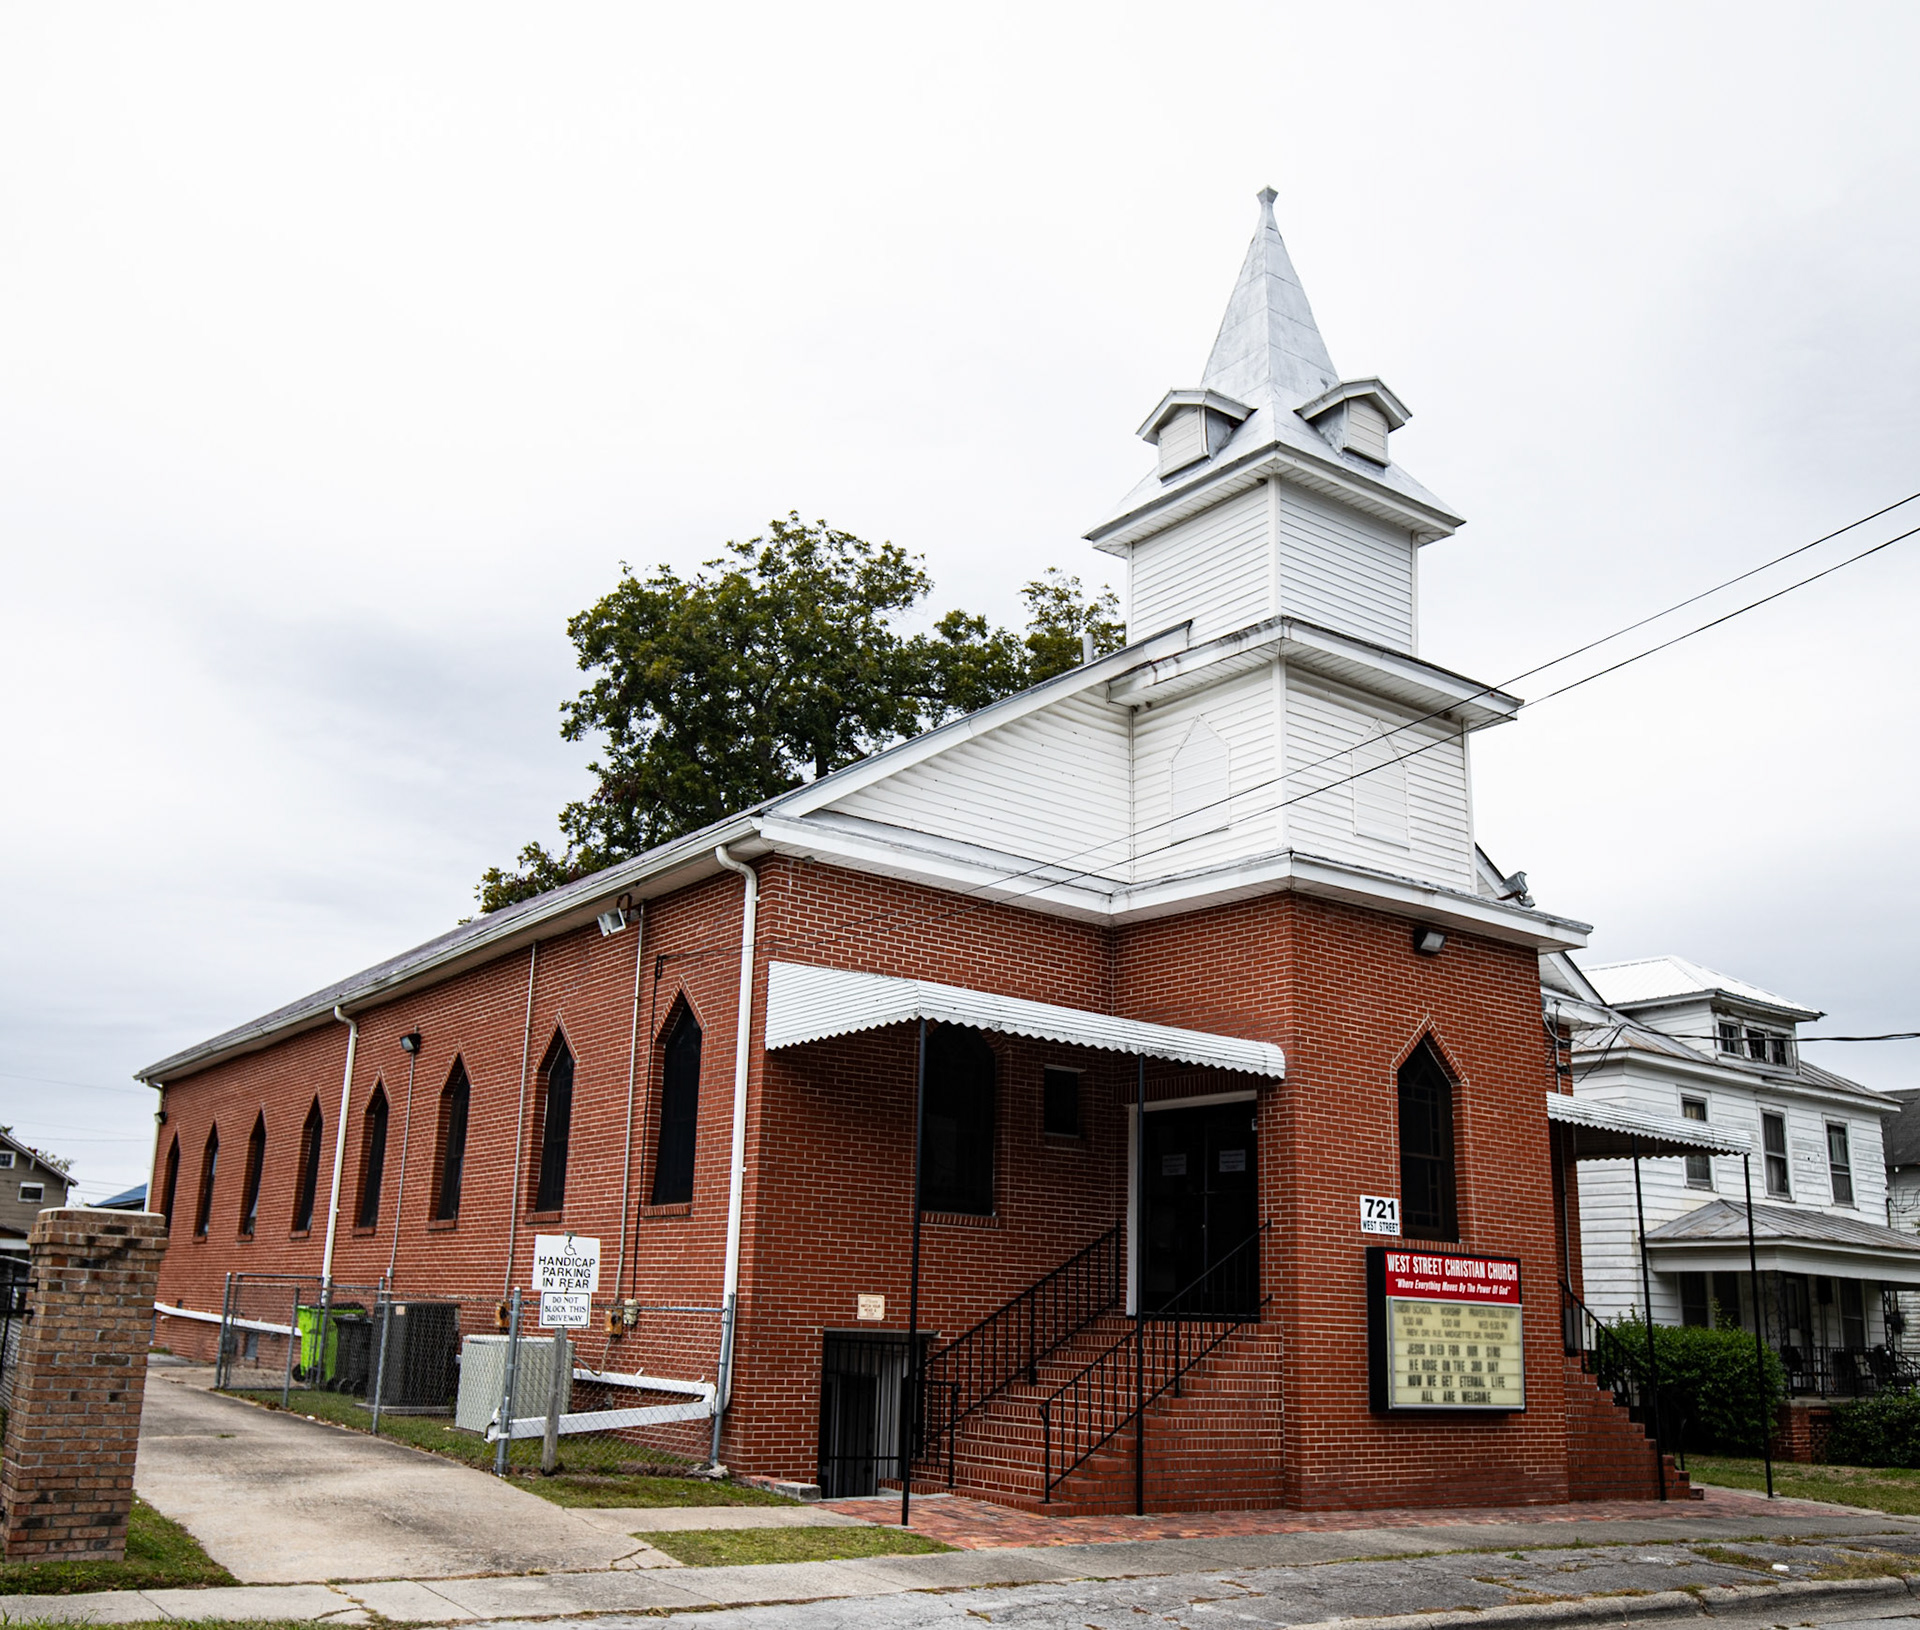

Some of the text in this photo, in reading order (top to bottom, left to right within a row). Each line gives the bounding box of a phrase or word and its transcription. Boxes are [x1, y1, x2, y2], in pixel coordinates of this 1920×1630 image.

[1365, 1199, 1394, 1219] 721
[1363, 1221, 1398, 1233] WEST STREET
[539, 1256, 595, 1267] HANDICAP
[1387, 1254, 1517, 1281] WEST STREET CHRISTIAN CHURCH
[543, 1267, 590, 1278] PARKING
[543, 1278, 589, 1288] IN REAR
[1415, 1280, 1441, 1292] Everything
[1442, 1282, 1458, 1291] Moves
[1459, 1283, 1466, 1293] By
[1467, 1283, 1475, 1293] The
[1476, 1284, 1491, 1294] Power
[1413, 1306, 1432, 1315] SCHOOL
[1408, 1344, 1500, 1358] JESUS DIED FOR OUR SINS
[1409, 1359, 1418, 1370] HE
[1422, 1360, 1437, 1371] ROSE
[1453, 1361, 1465, 1372] THE
[1488, 1362, 1498, 1372] DAY
[1427, 1375, 1436, 1386] WE
[1442, 1375, 1453, 1387] GET
[1460, 1376, 1485, 1387] ETERNAL
[1491, 1376, 1505, 1388] LIFE
[1422, 1391, 1491, 1403] ALL ARE WELCOME
